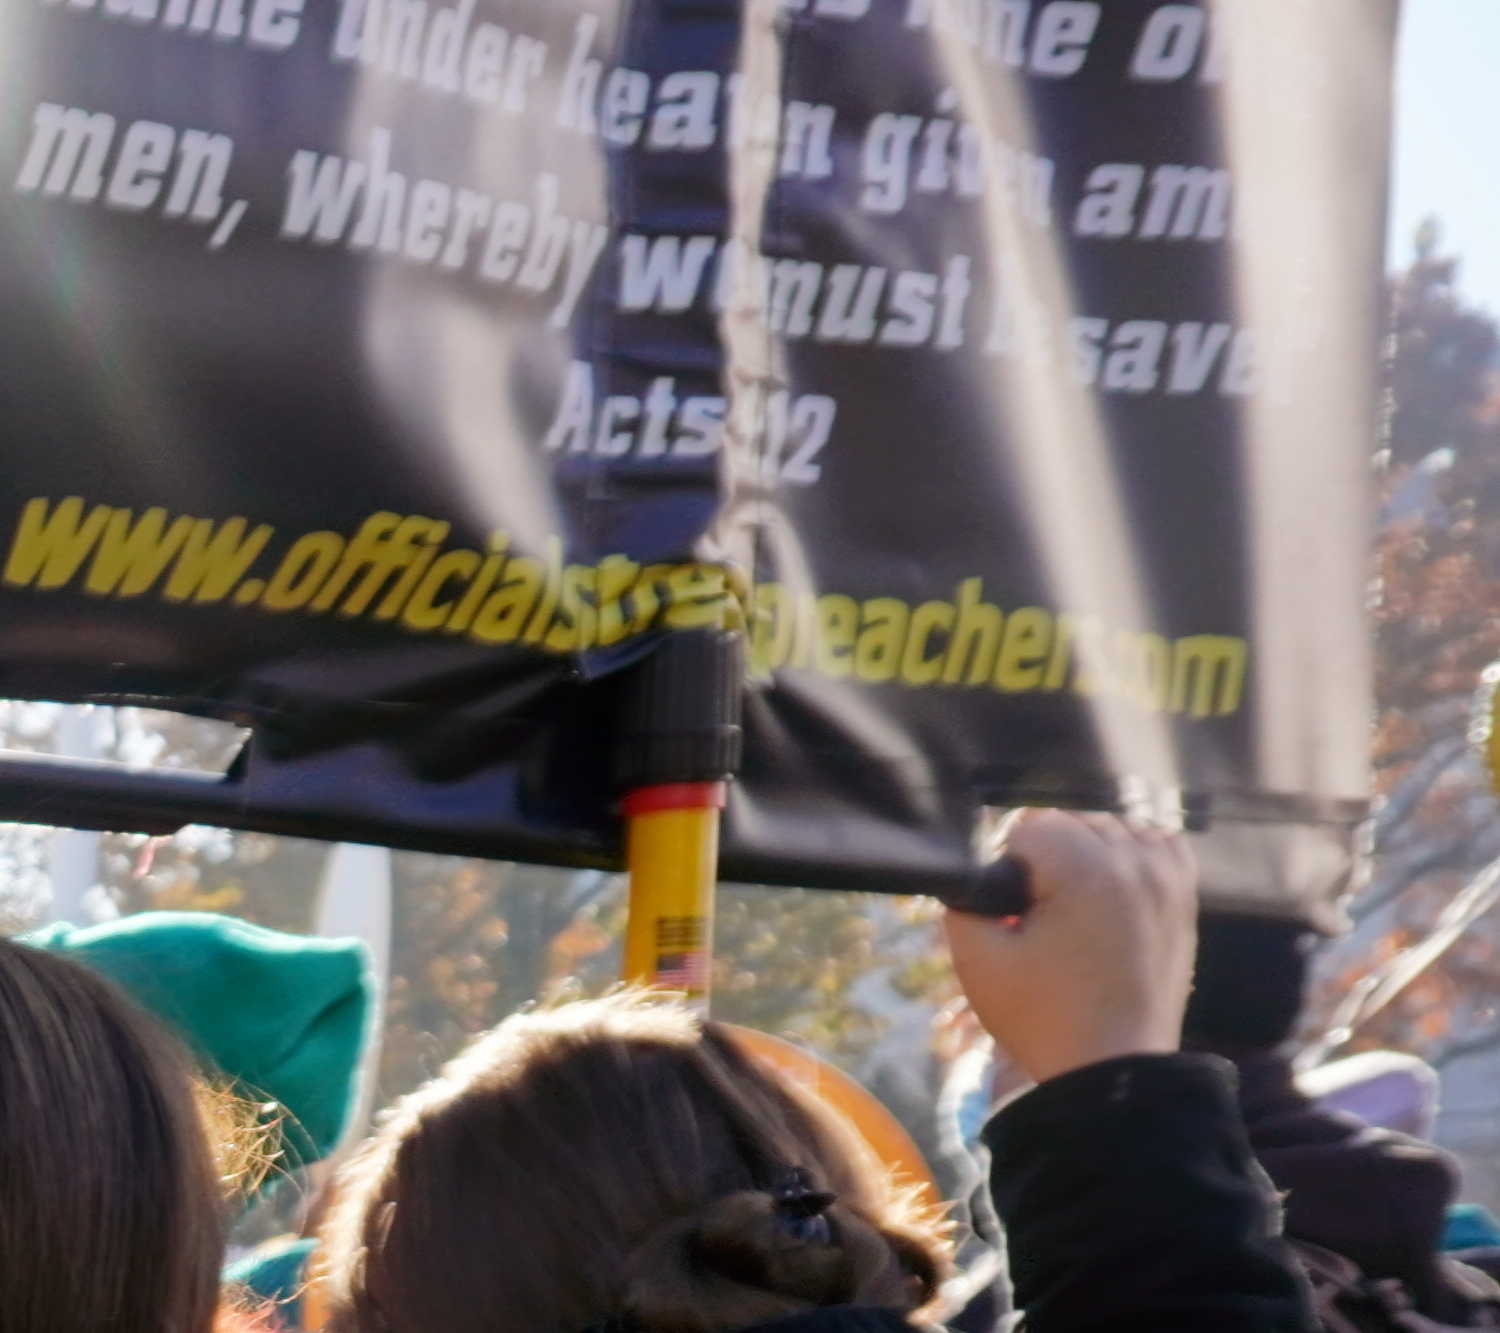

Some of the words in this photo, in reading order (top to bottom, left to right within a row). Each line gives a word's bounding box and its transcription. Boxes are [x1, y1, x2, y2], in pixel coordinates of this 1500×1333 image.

[15, 102, 248, 250] men,
[280, 126, 608, 329] whereby
[545, 359, 729, 456] Acts
